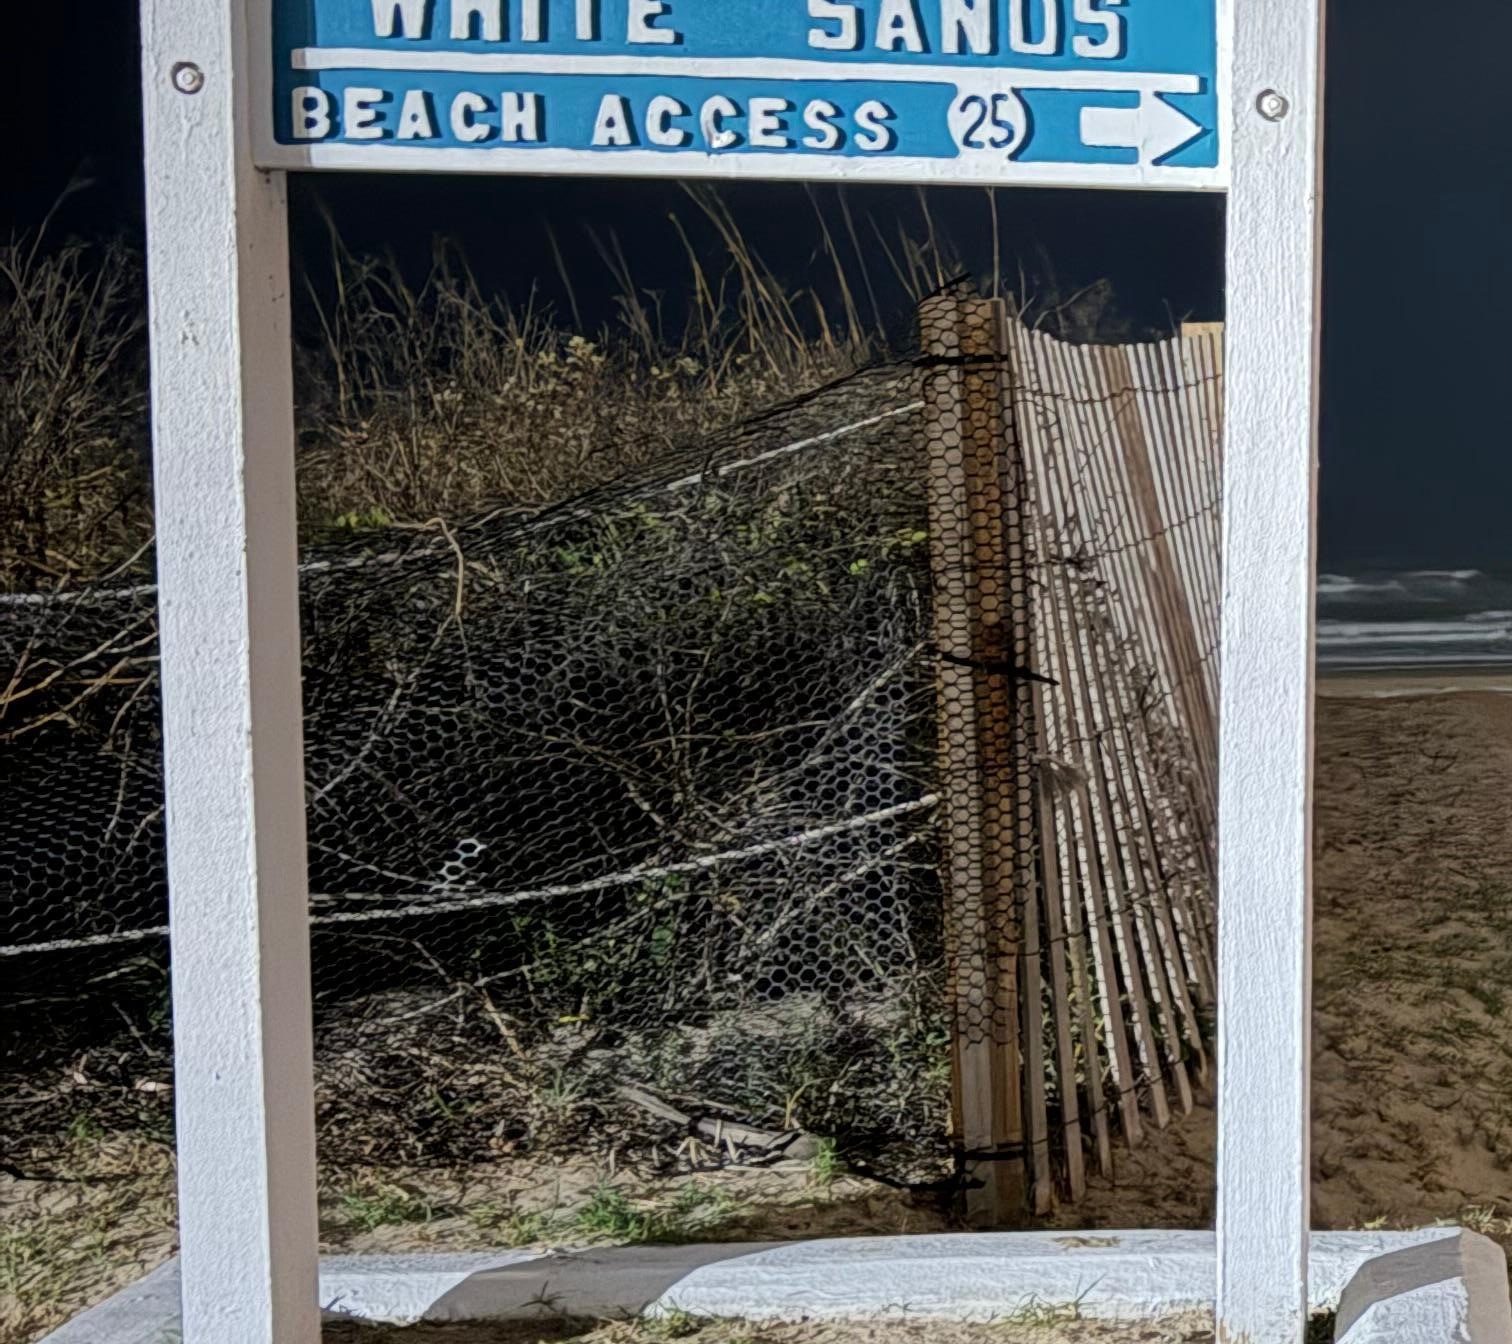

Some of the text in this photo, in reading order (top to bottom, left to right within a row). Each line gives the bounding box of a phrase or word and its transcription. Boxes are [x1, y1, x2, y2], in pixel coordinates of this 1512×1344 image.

[292, 86, 1015, 151] BEACH ACCESS 25
